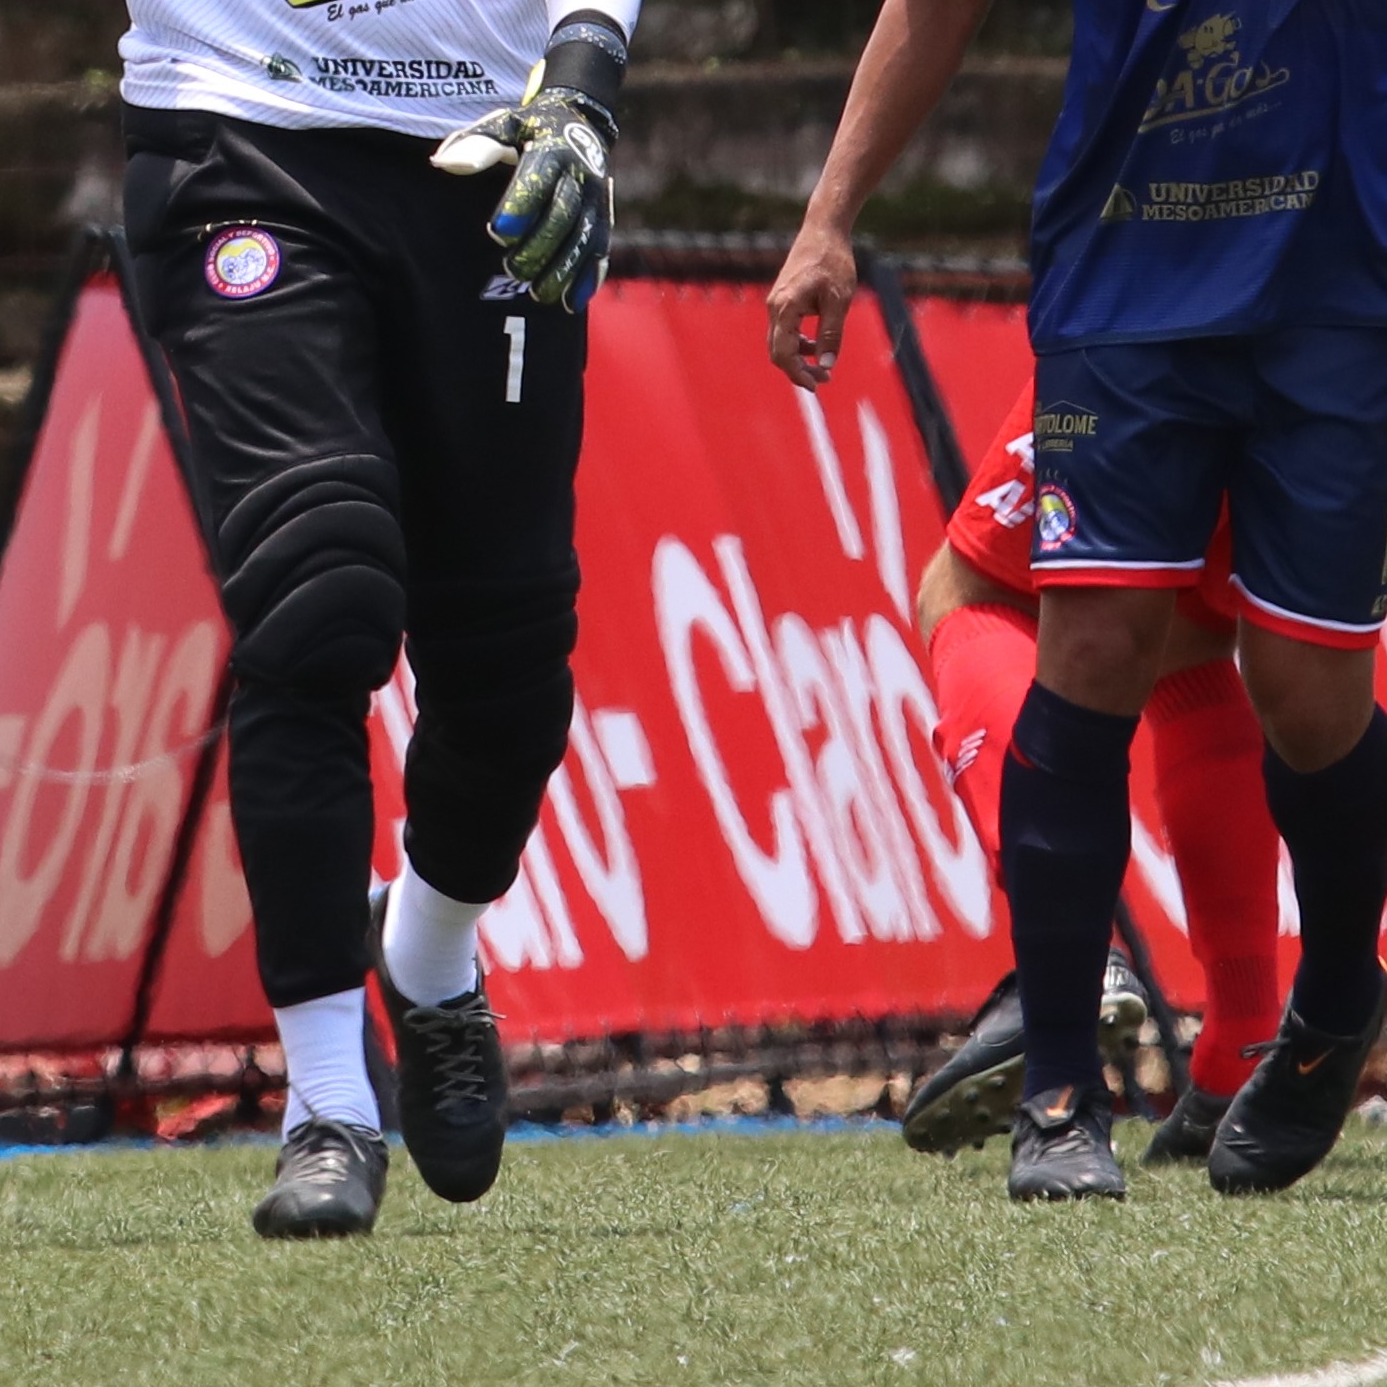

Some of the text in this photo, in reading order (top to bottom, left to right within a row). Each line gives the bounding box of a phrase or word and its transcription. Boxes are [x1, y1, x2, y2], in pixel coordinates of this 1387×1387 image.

[327, 4, 344, 21] El
[348, 2, 370, 20] gas
[312, 56, 485, 79] UNIVERSIDAD
[1148, 170, 1319, 203] UNIVERSIDAD
[504, 316, 526, 403] 1
[652, 535, 992, 949] Claro
